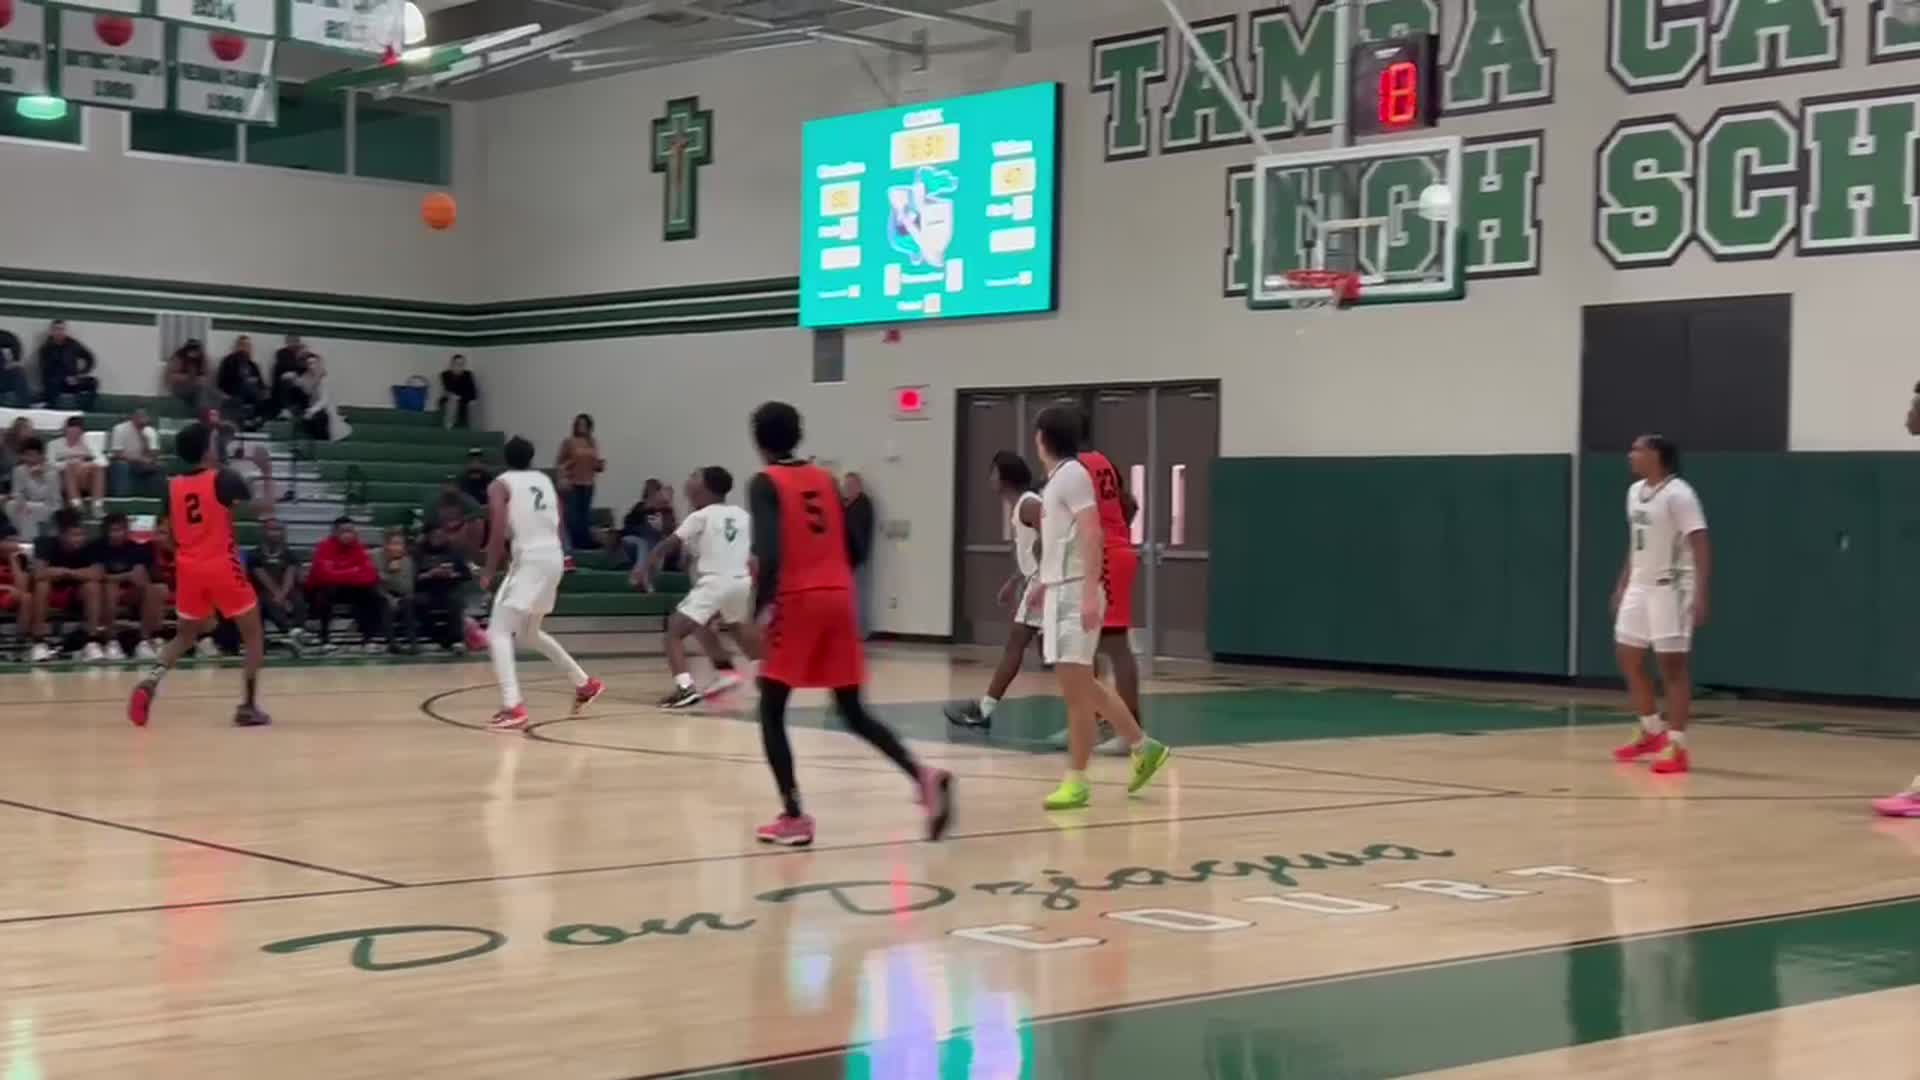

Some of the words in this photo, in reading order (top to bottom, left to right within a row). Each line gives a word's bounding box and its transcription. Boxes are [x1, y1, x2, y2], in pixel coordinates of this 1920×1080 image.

[184, 492, 204, 525] 2
[529, 486, 547, 512] 2
[947, 863, 1645, 951] COURT
